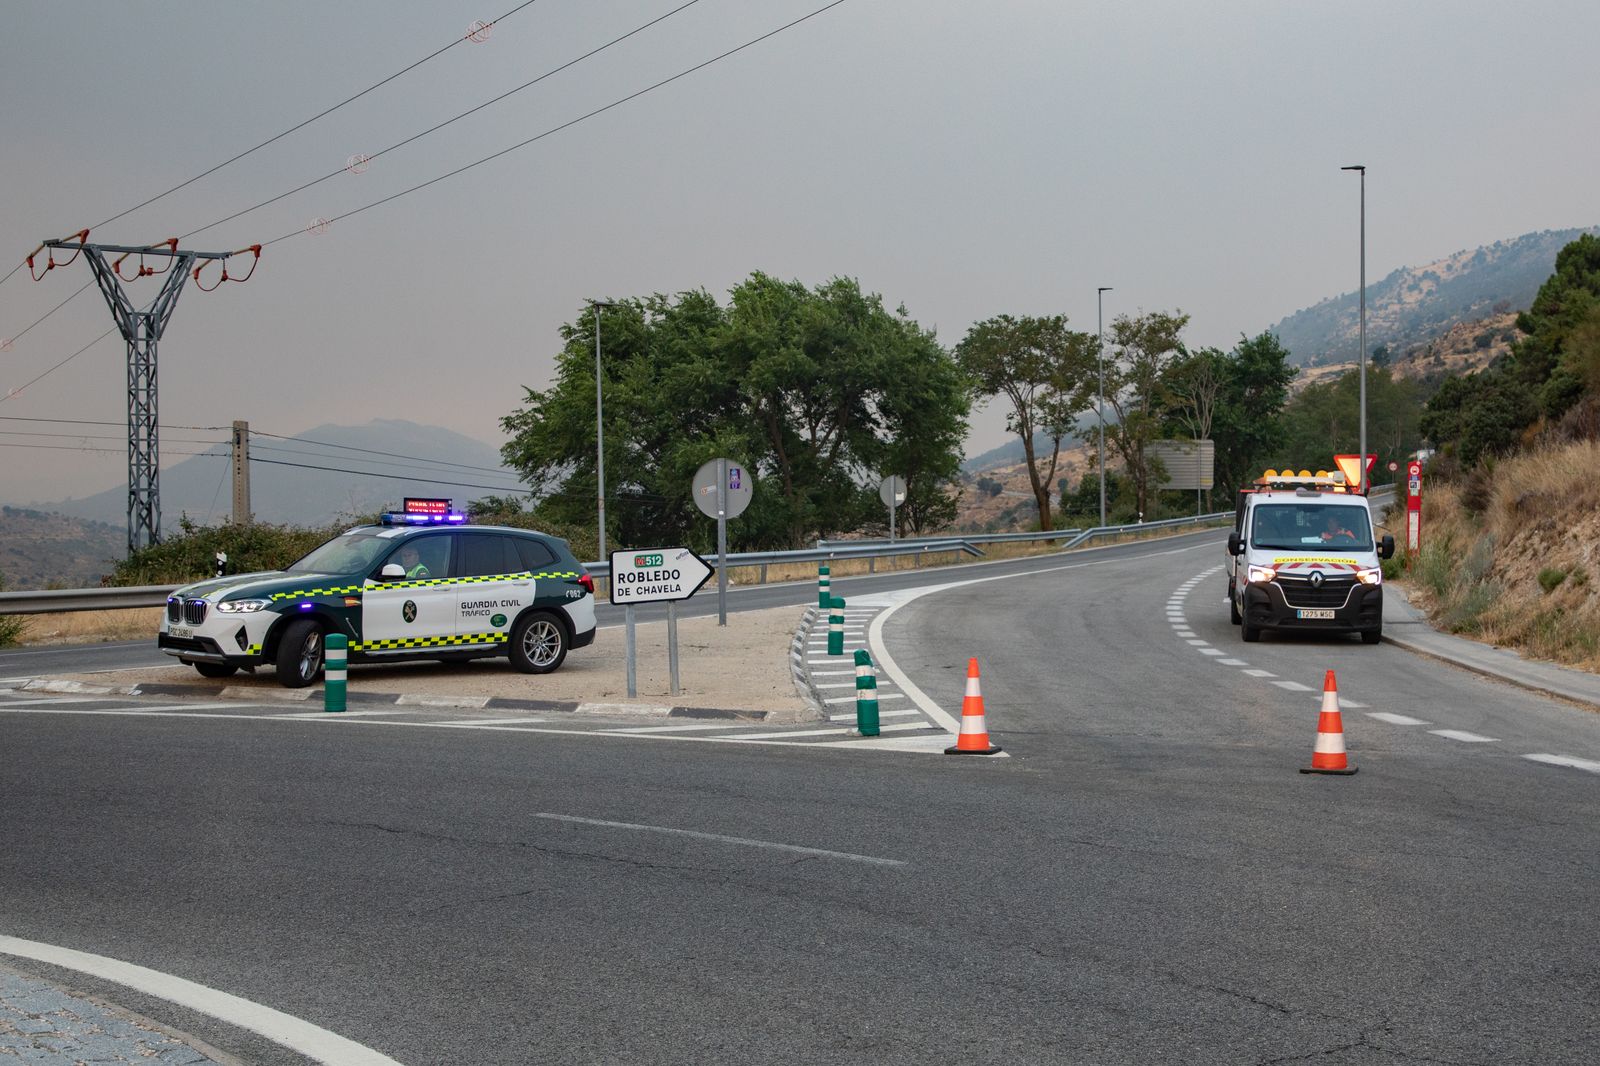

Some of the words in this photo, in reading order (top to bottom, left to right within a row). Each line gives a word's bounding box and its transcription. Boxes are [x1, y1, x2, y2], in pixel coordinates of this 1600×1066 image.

[618, 569, 681, 584] ROBLEDO
[617, 587, 631, 597] DE
[636, 584, 681, 595] CHAVELA
[461, 600, 498, 609] GUARDIA
